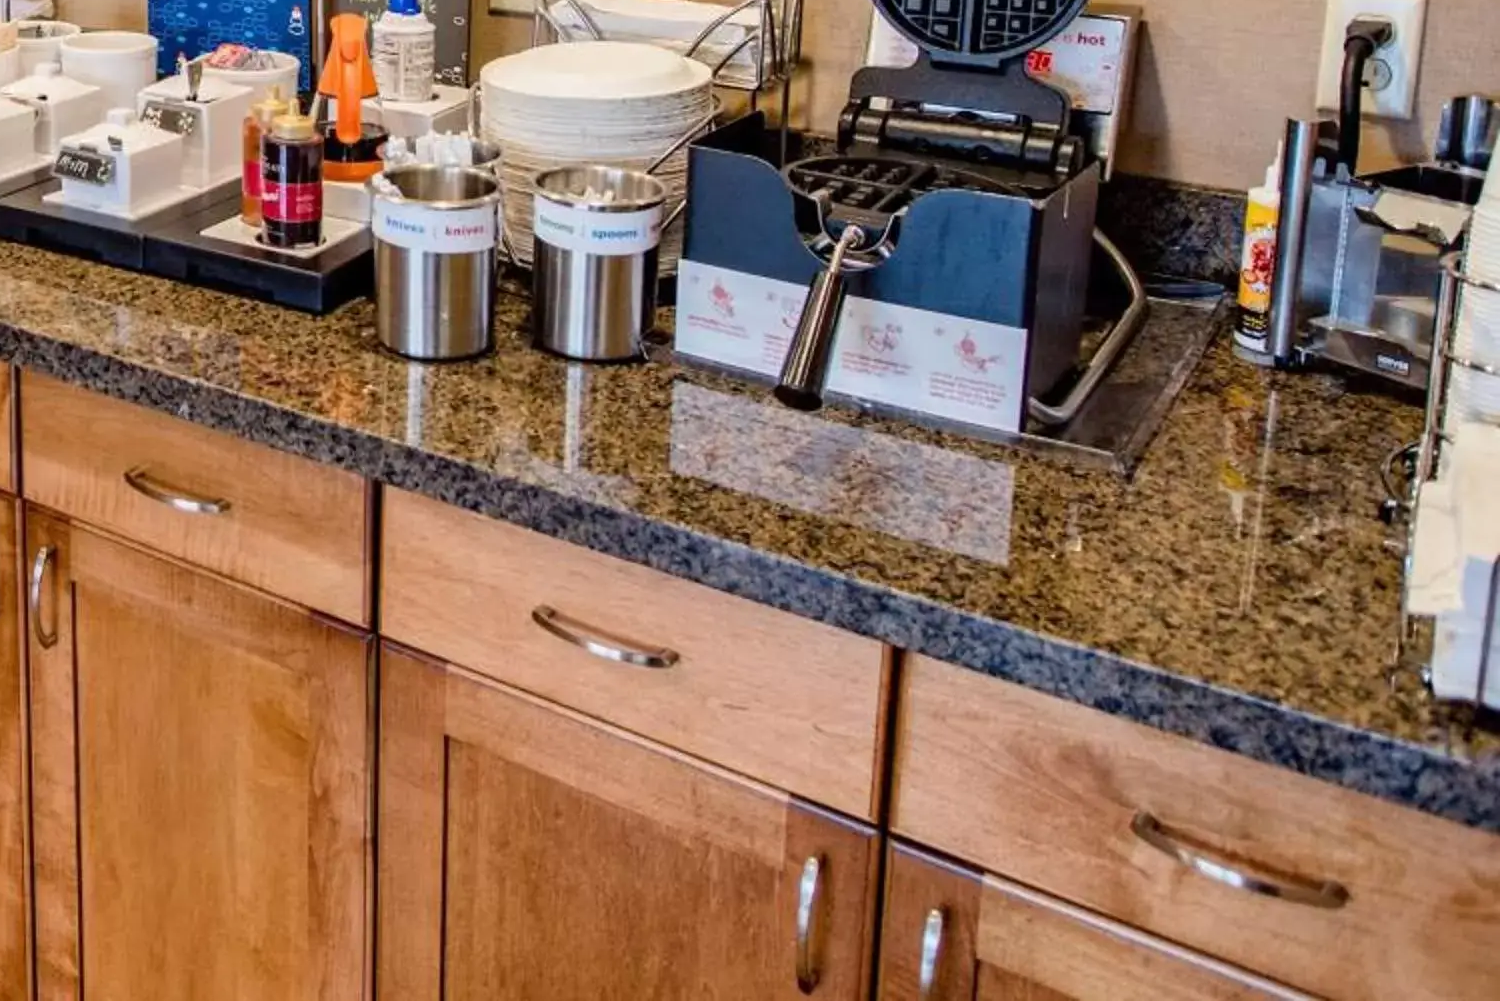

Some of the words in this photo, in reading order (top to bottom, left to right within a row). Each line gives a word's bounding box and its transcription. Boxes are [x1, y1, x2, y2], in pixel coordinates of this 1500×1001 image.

[1077, 31, 1107, 47] hot
[385, 214, 426, 235] knives
[444, 222, 486, 238] knives
[590, 225, 640, 241] spoons
